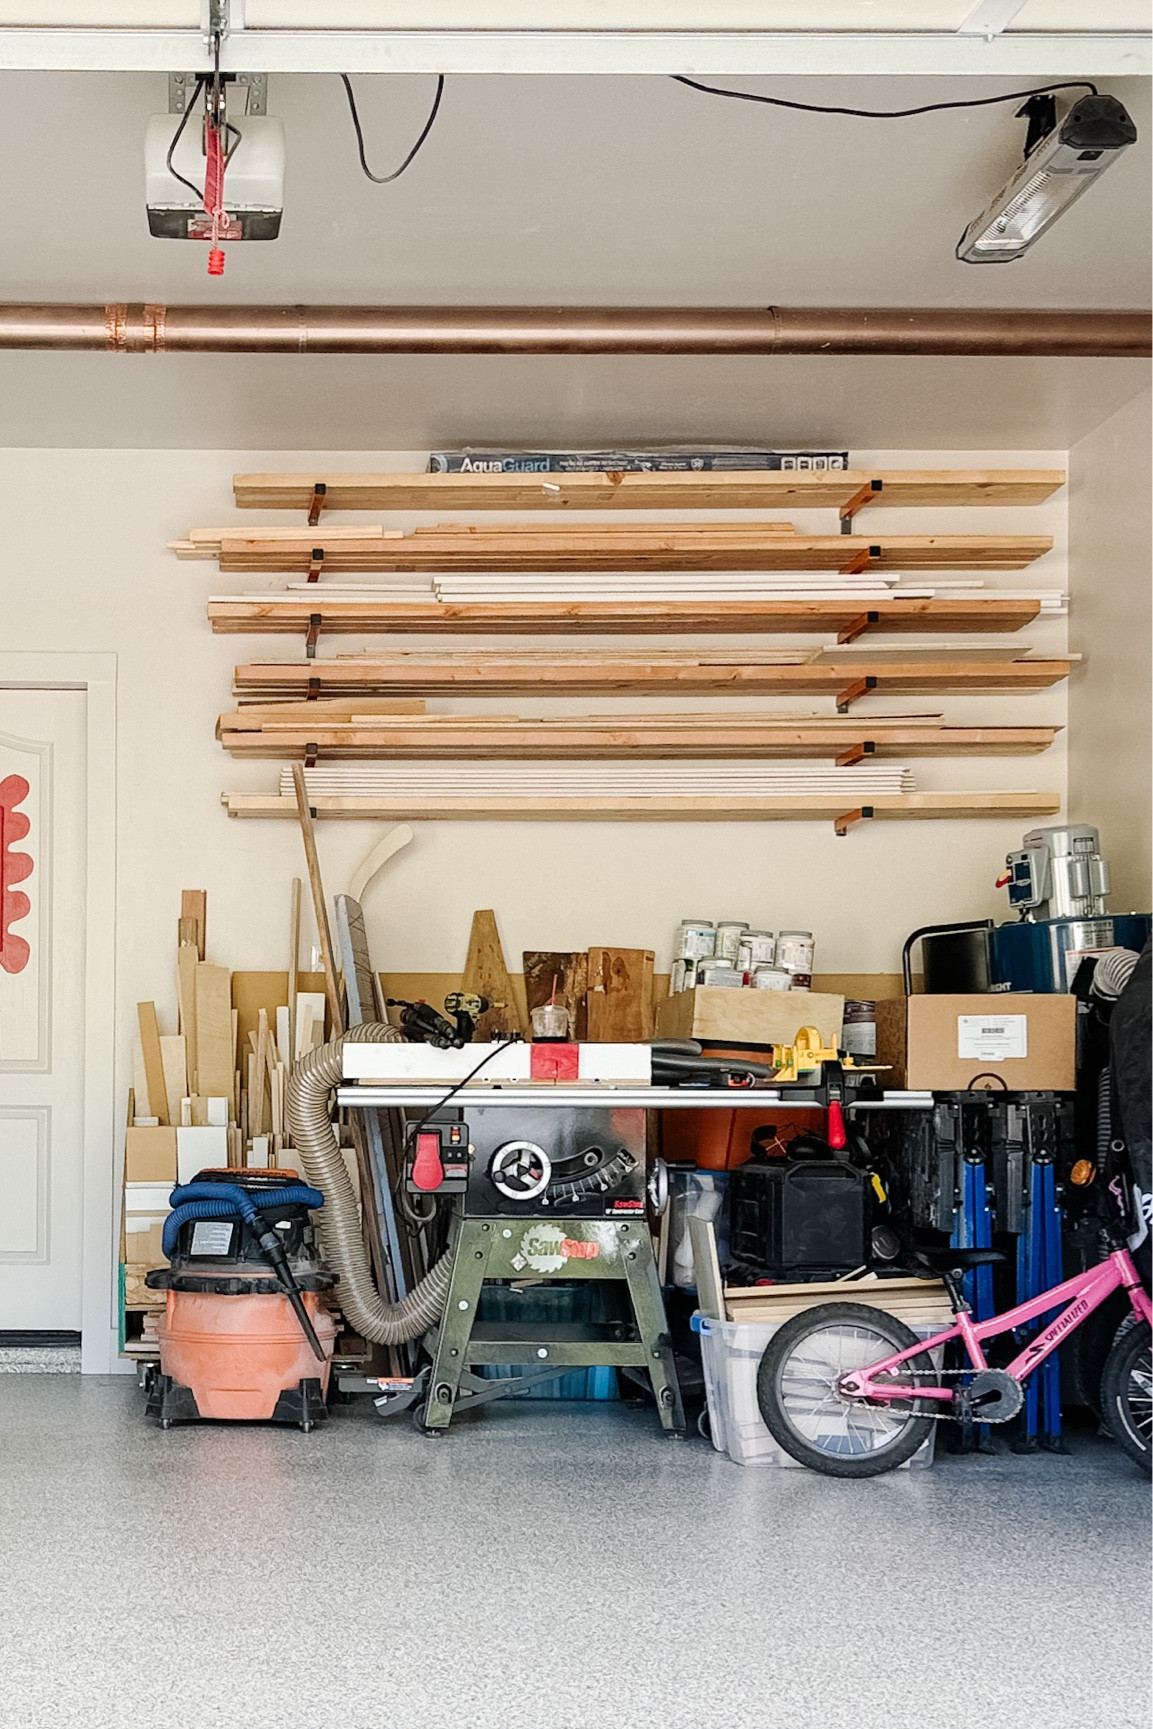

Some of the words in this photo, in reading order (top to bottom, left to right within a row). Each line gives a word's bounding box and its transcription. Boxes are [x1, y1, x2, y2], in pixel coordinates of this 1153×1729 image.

[460, 457, 550, 473] AquaGuard
[527, 1237, 600, 1259] SawStop
[1044, 1299, 1089, 1341] SPECIALIZED
